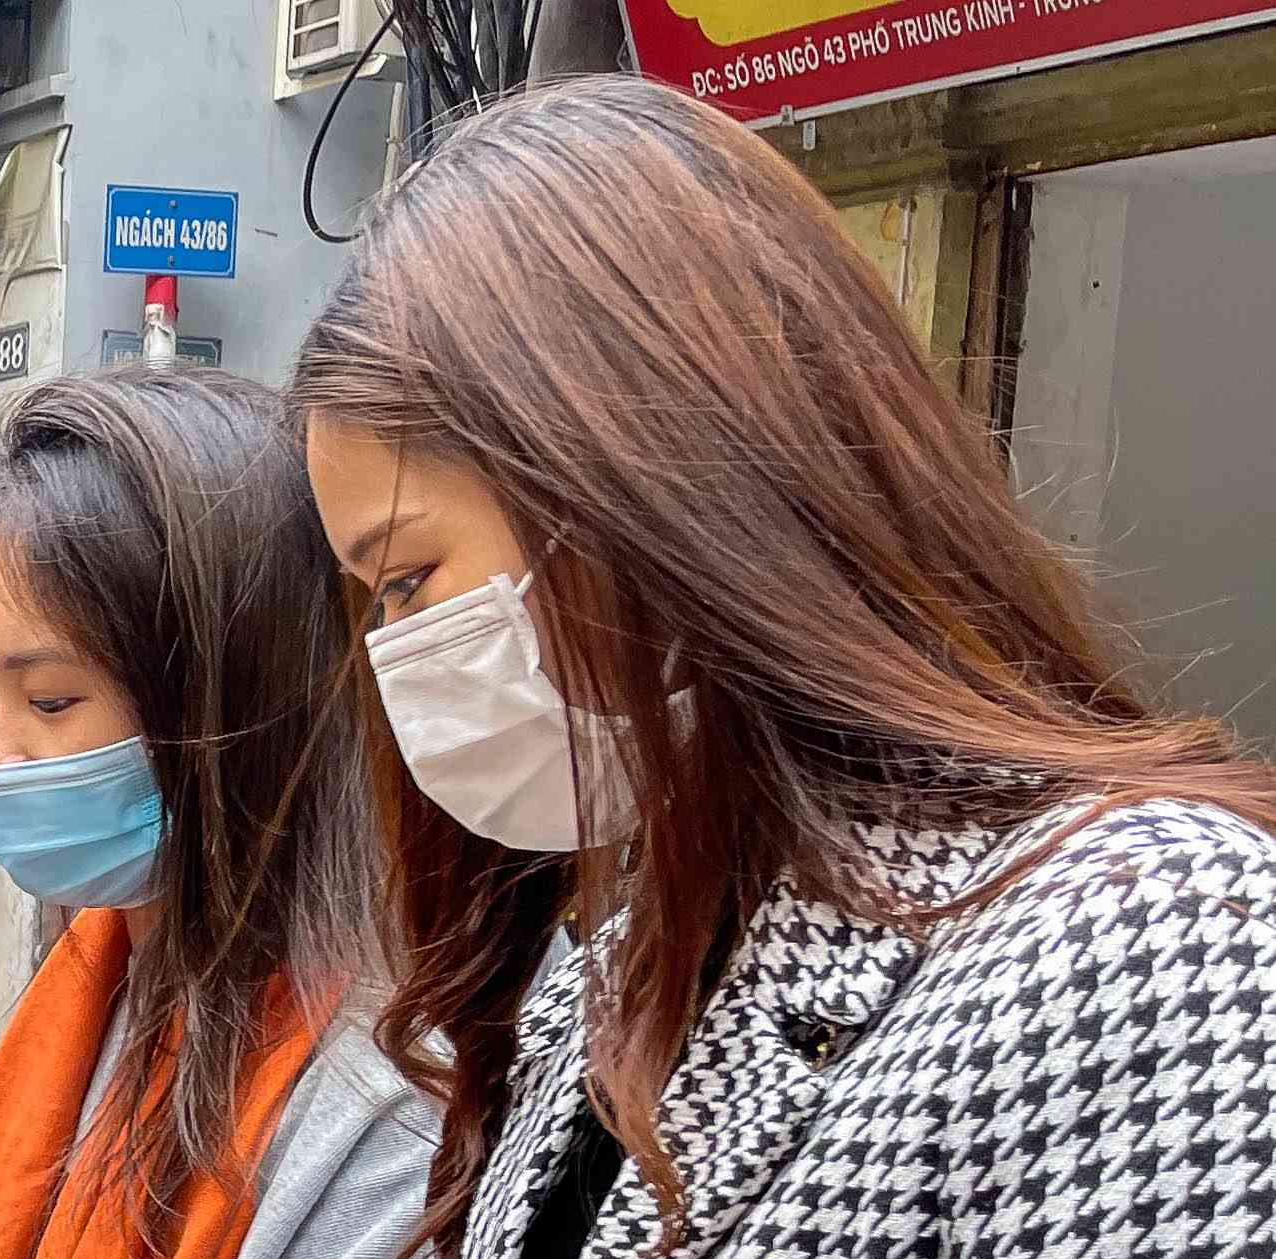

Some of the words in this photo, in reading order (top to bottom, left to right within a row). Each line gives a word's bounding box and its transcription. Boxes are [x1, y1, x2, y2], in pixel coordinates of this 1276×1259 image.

[692, 67, 724, 98] ĐC:
[724, 52, 750, 92] SỐ
[751, 54, 776, 85] 86
[777, 36, 820, 80] NGÕ
[823, 37, 847, 65] 43
[848, 18, 890, 62] PHỐ
[892, 10, 963, 51] TRUNG
[115, 210, 176, 250] NGÁCH
[179, 218, 229, 253] 43/86
